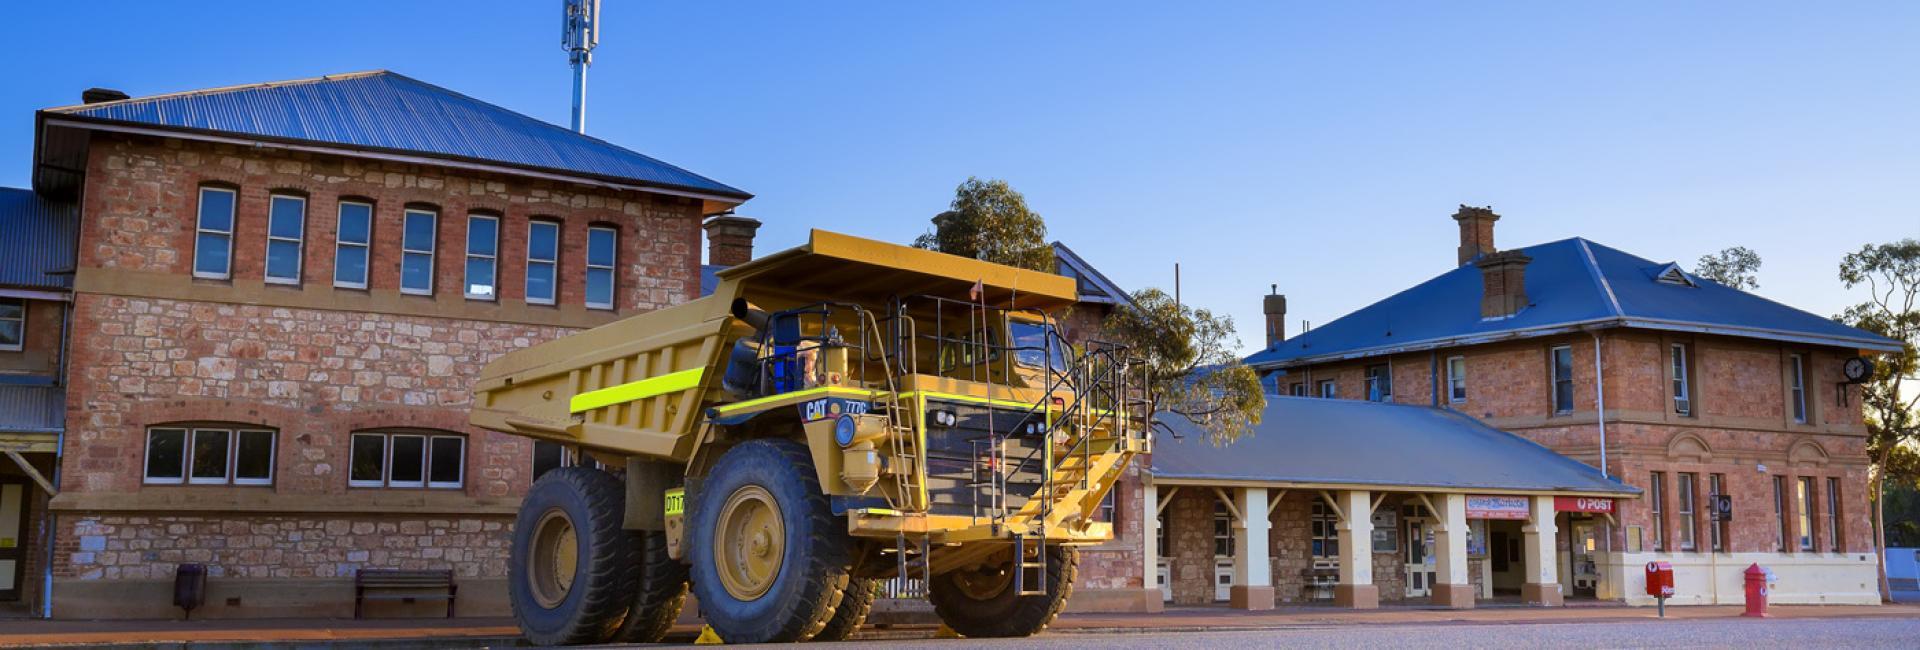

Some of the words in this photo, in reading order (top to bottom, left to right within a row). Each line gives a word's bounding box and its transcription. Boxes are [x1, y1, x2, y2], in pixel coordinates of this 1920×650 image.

[806, 400, 827, 420] CAT
[845, 400, 867, 414] 777C
[1587, 499, 1612, 510] POST
